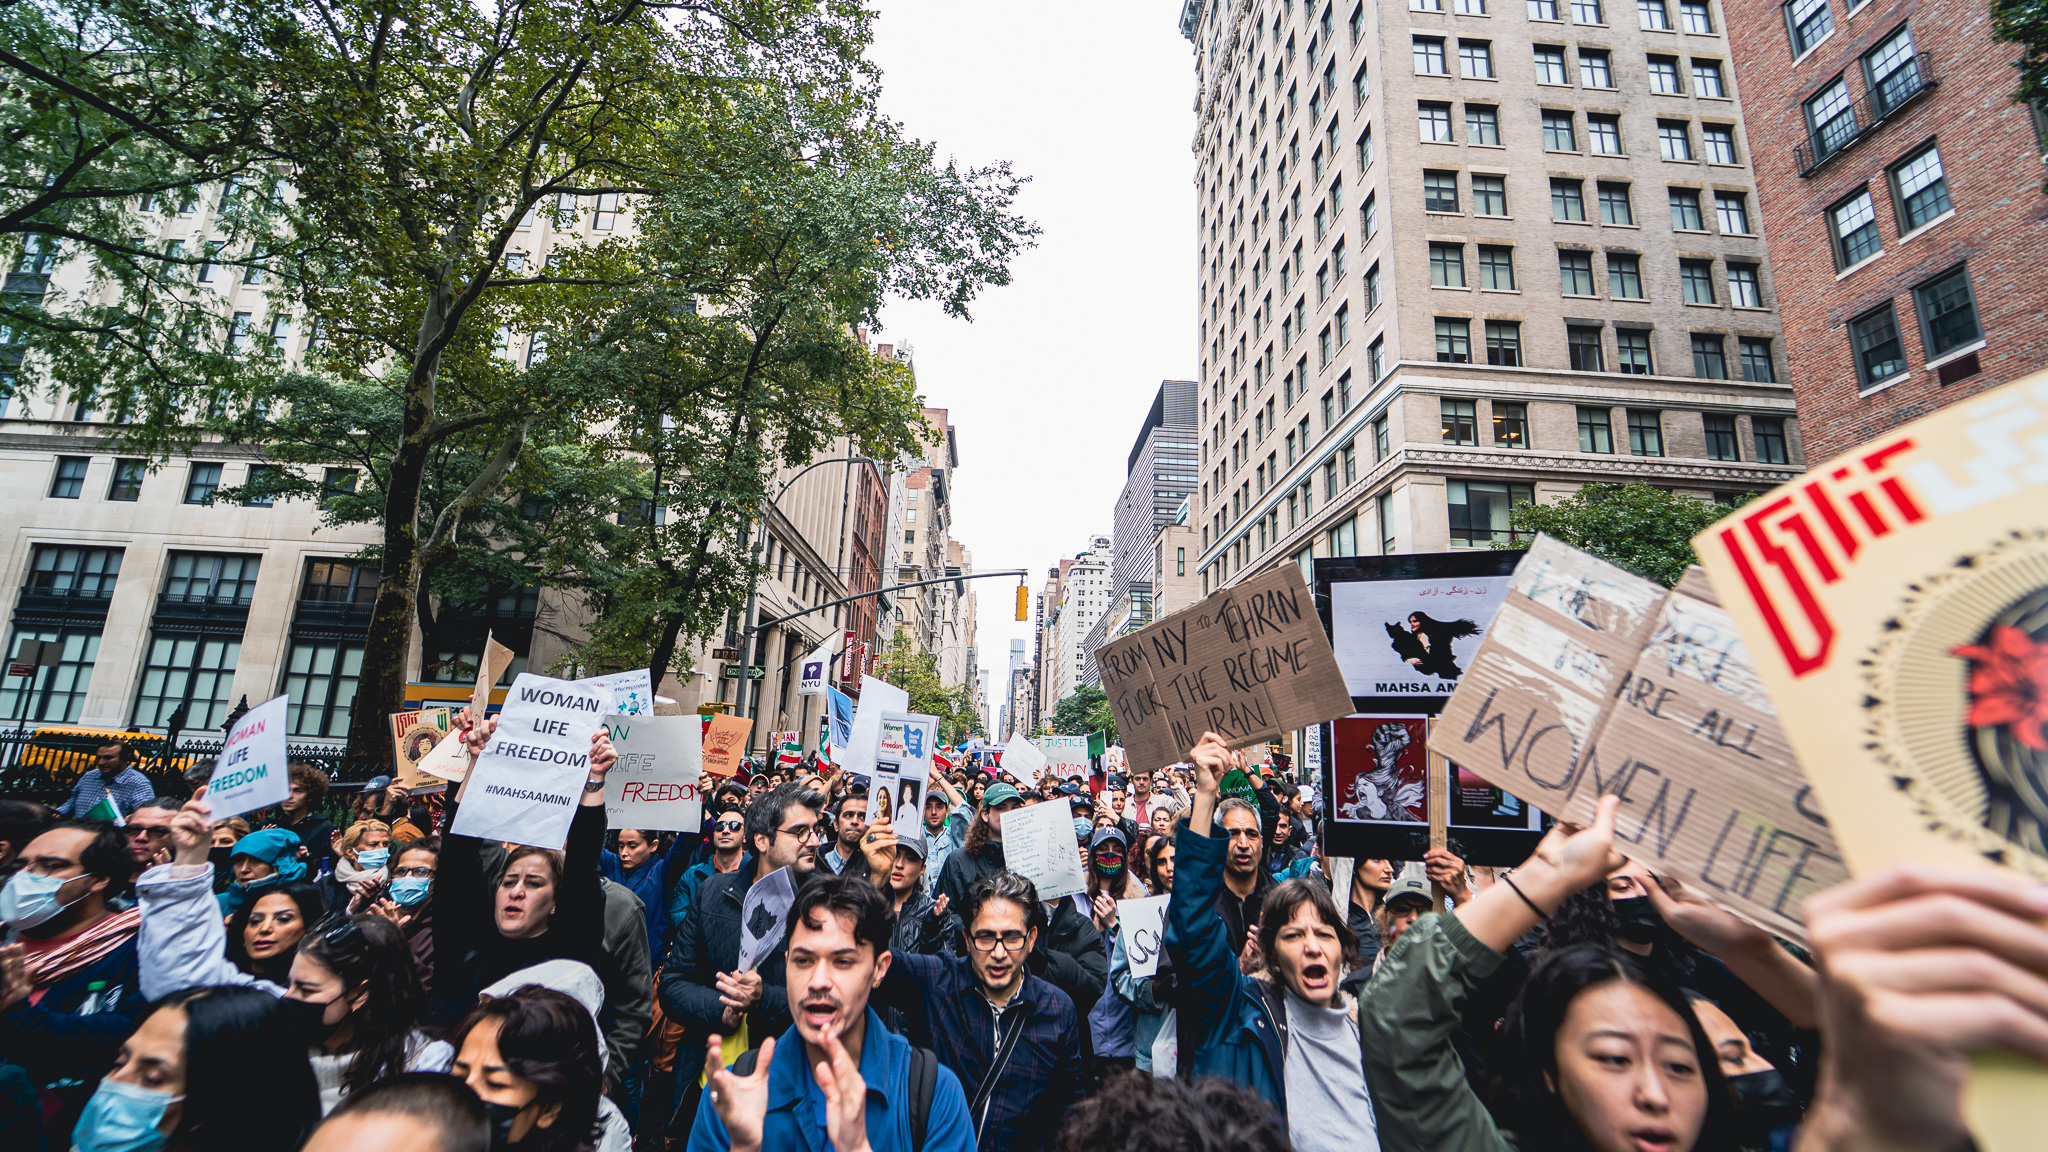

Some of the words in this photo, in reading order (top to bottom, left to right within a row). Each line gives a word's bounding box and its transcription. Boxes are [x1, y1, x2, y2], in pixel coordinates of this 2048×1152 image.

[1475, 586, 1487, 595] زن
[1102, 642, 1150, 684] FROM
[1151, 619, 1187, 668] NY
[1196, 613, 1210, 630] TO
[1214, 586, 1301, 643] TEHRAN
[801, 680, 821, 688] NYU
[1117, 682, 1169, 731] FUCK
[1167, 665, 1217, 710] THE
[1223, 638, 1308, 693] REGIME
[1375, 683, 1432, 693] MAHSA
[1436, 683, 1459, 693] AM
[521, 687, 600, 713] WOMAN
[1171, 715, 1195, 750] IN
[1205, 698, 1267, 739] IRAN
[1613, 670, 1679, 720] ARE
[1693, 706, 1763, 760] ALL
[533, 718, 570, 737] LIFE
[883, 722, 903, 732] Women
[881, 740, 904, 750] Freedom
[1044, 738, 1086, 748] JUSTICE
[227, 746, 249, 767] LIFE
[495, 741, 588, 768] FREEDOM
[208, 763, 269, 796] FREEDOM
[1056, 762, 1087, 777] IRAN
[1463, 688, 1696, 860] WOMEN
[485, 784, 571, 807] #MAHSAAMINI
[621, 782, 703, 803] FREEDOM
[1226, 785, 1253, 794] WOMA
[1047, 820, 1058, 873] FREEDOM
